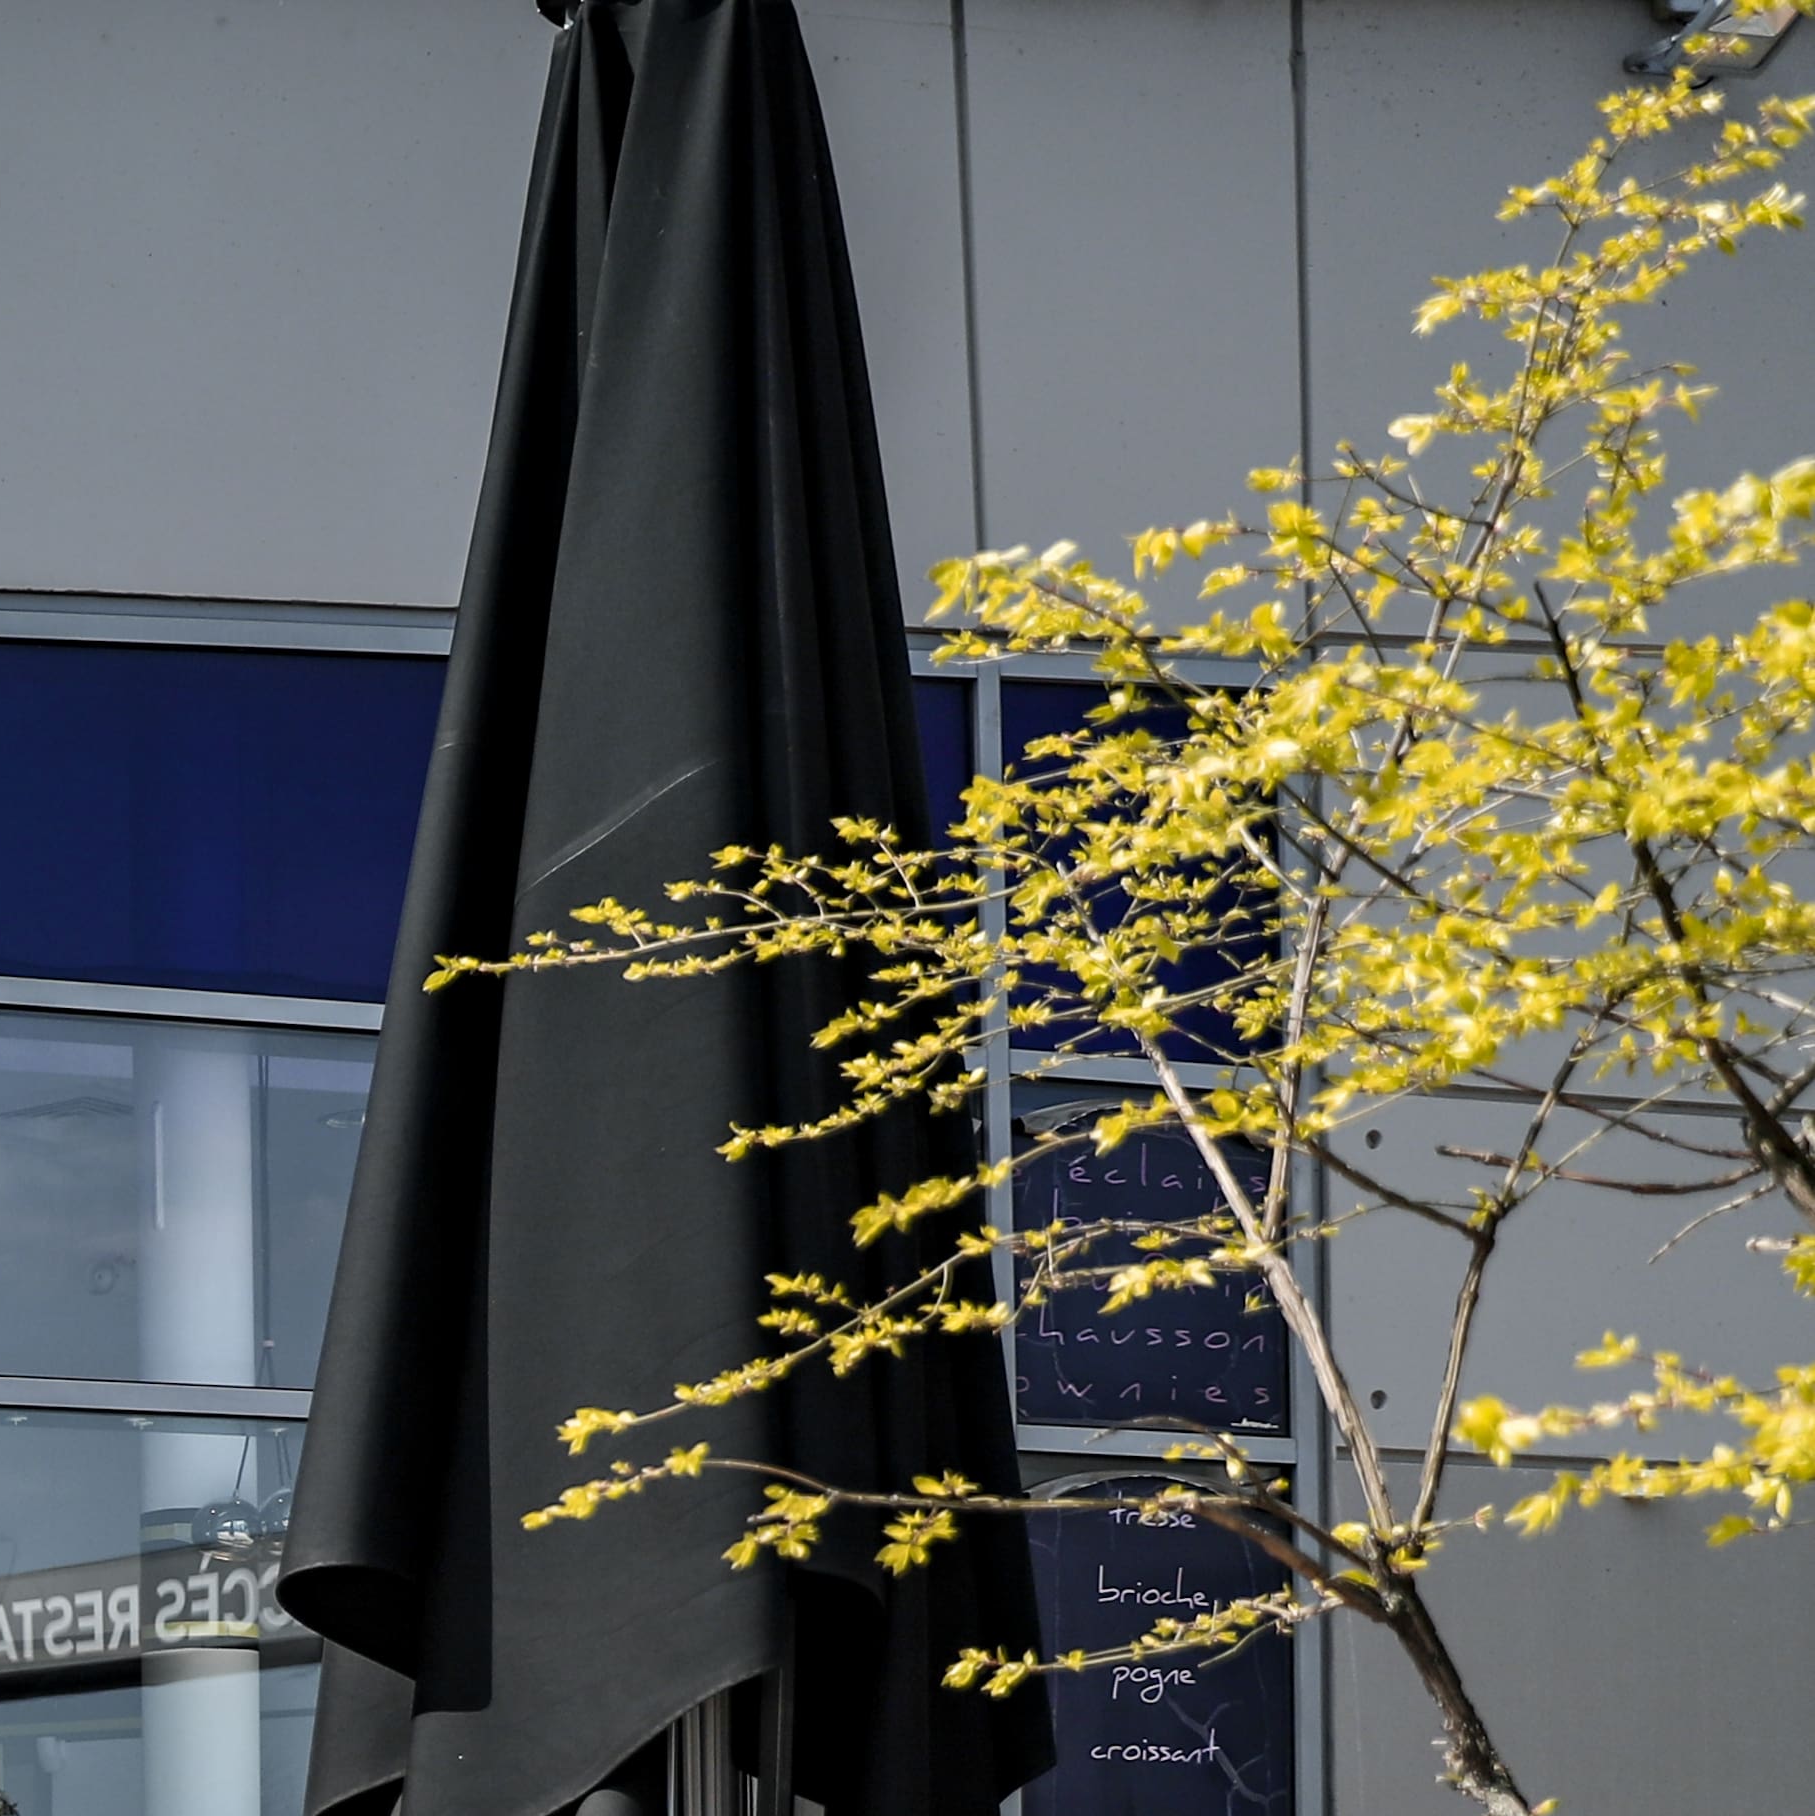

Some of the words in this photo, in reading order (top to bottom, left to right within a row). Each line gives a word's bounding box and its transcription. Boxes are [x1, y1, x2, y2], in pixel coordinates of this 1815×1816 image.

[1018, 1300, 1266, 1352] hausson
[1098, 1564, 1209, 1610] brioche
[1112, 1665, 1196, 1703] pogne
[1091, 1728, 1220, 1764] croissant
